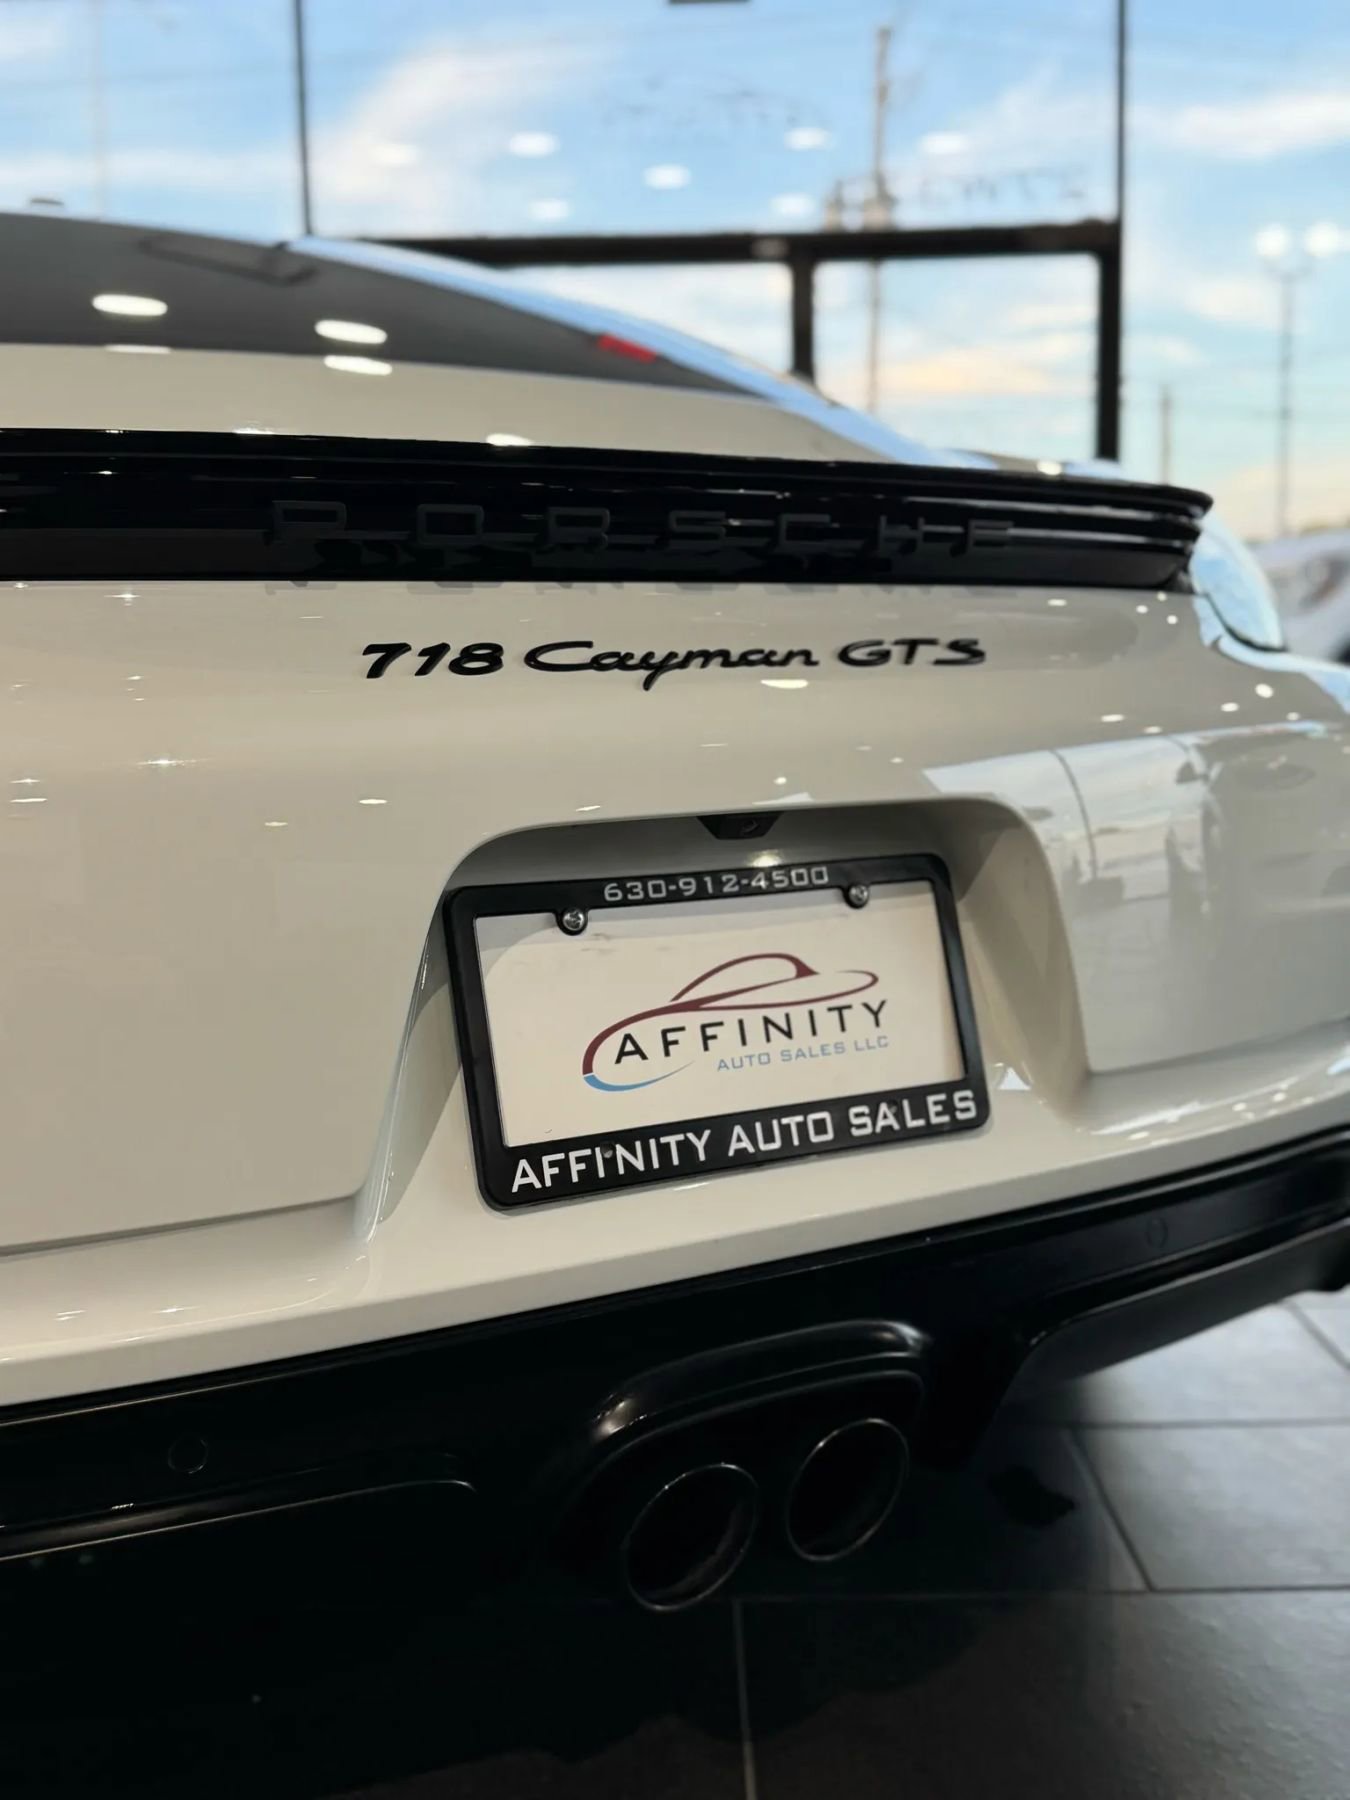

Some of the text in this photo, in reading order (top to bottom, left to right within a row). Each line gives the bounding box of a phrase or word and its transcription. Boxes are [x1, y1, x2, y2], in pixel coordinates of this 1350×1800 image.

[271, 499, 1015, 556] PORSCHE
[362, 637, 986, 692] 718 Cayman GTS
[603, 865, 830, 902] 630-912-4500
[614, 1000, 888, 1065] AFFINITY
[716, 1035, 890, 1073] AUTO SALES LLC
[511, 1089, 978, 1193] AFFINITY AUTO SALES
